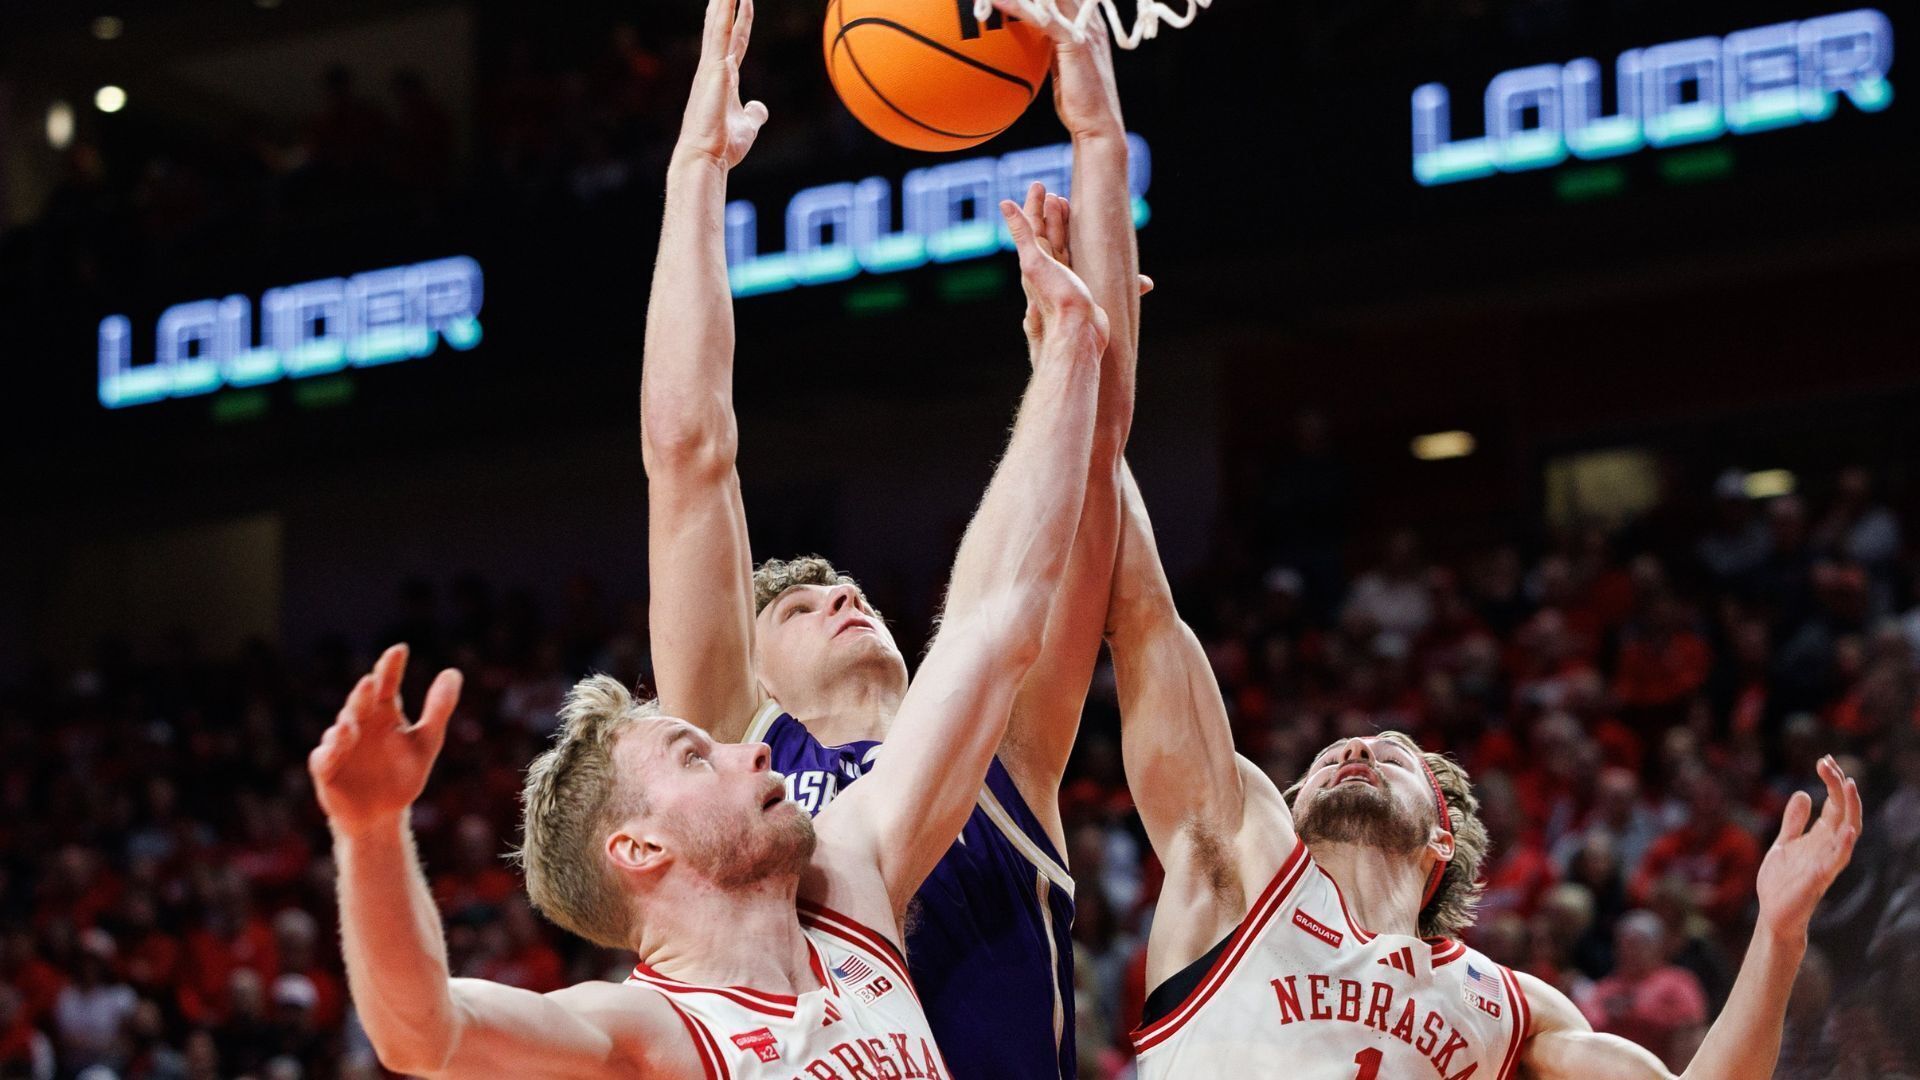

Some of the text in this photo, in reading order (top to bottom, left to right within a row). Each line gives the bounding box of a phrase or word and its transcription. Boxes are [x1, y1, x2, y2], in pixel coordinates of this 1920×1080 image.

[1411, 8, 1894, 186] LOUDER
[724, 132, 1151, 299] LOUDE
[98, 255, 484, 409] LOUDER
[1295, 914, 1340, 944] GRADUATE
